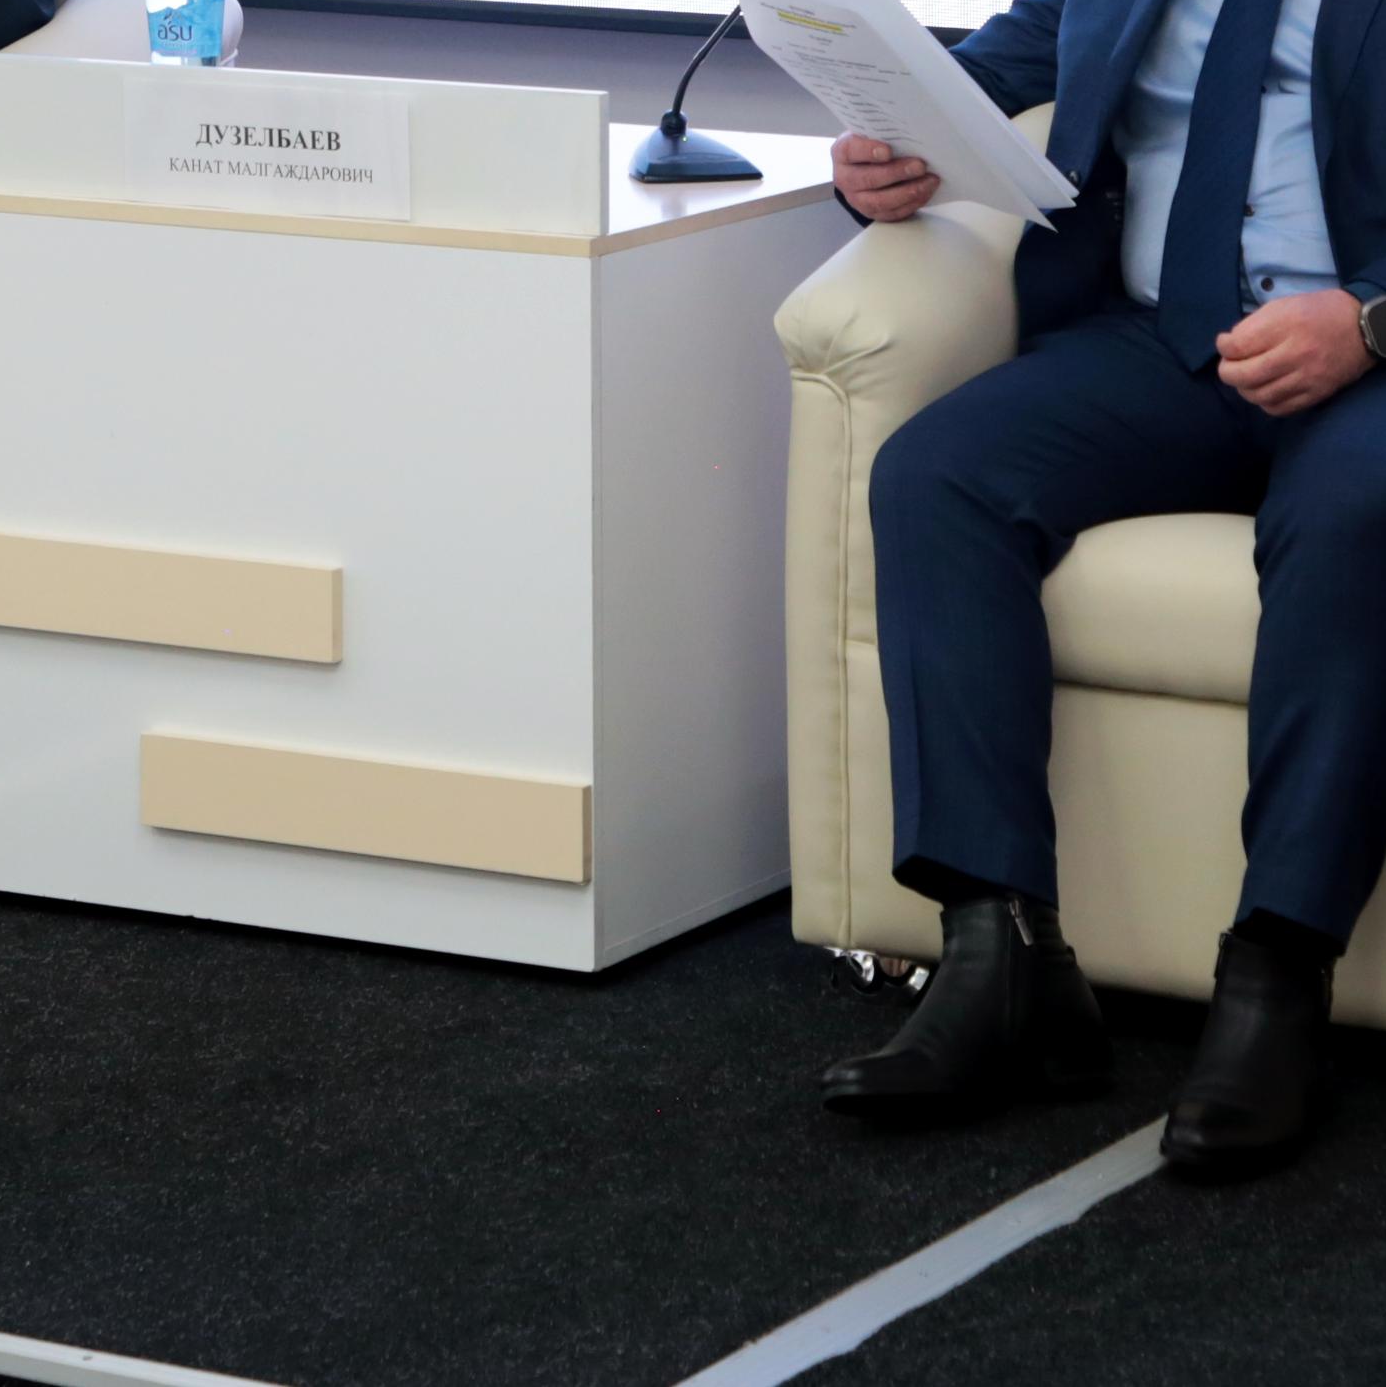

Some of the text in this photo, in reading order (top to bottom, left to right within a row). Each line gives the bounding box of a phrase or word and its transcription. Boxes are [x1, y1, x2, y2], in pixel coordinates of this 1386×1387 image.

[195, 123, 342, 152] ДУЗЕЛБАЕВ
[169, 157, 374, 184] КАНАТ МАЛГАЖДАРОВИЧ
